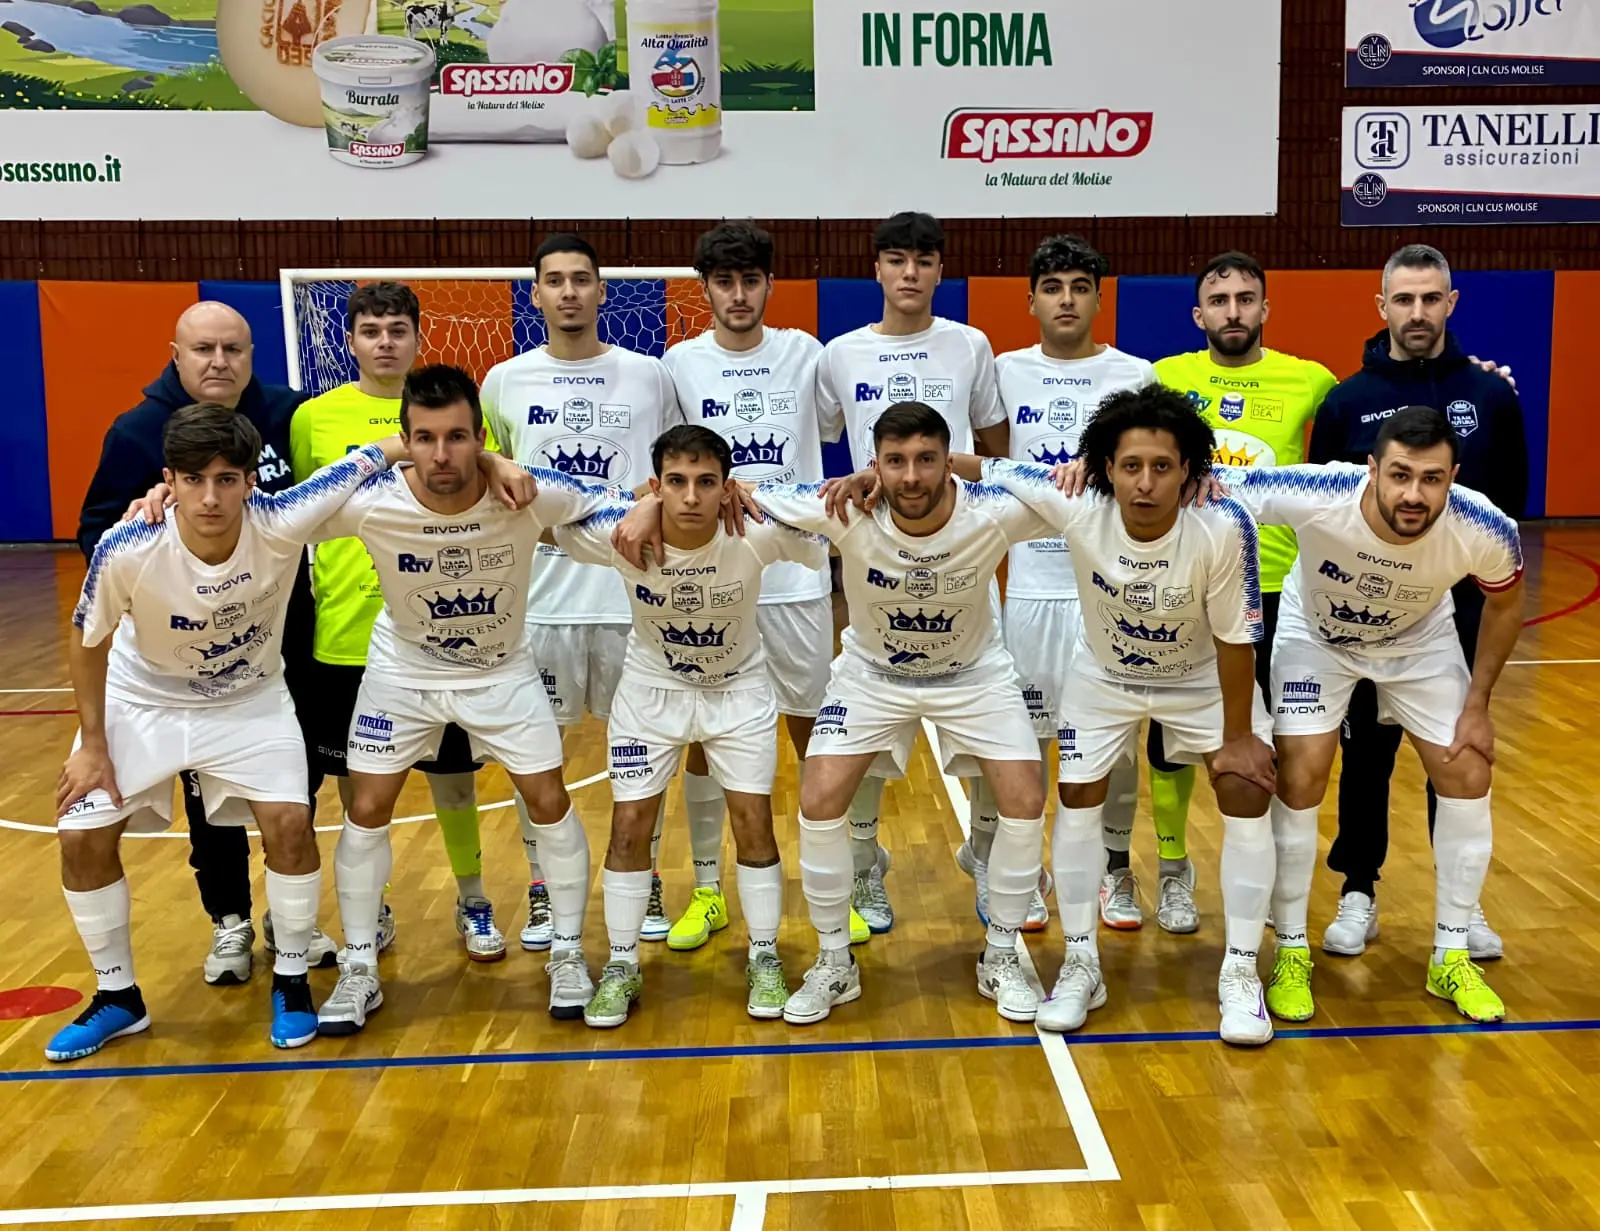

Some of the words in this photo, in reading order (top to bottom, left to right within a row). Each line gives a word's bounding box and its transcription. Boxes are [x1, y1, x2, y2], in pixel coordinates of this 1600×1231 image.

[641, 38, 664, 48] Alta
[667, 36, 709, 50] Qualità
[862, 13, 900, 66] IN
[913, 13, 1053, 66] FORMA
[1360, 44, 1389, 58] CLN
[1422, 66, 1466, 76] SPONSOR
[1471, 65, 1490, 75] CLN
[1491, 65, 1510, 75] CUS
[1511, 64, 1545, 75] MOLISE
[450, 64, 566, 96] SASSANO
[1422, 112, 1600, 146] TANELLI
[960, 111, 1140, 161] SASSANO
[352, 143, 402, 156] SASSANO
[1444, 148, 1580, 166] assicurazioni
[0, 154, 122, 183] sassano.it
[985, 172, 998, 187] la
[1000, 172, 1047, 187] Natura
[1050, 172, 1069, 187] del
[1072, 171, 1113, 187] Molise
[1355, 182, 1384, 196] CLN
[1417, 203, 1460, 213] SPONSOR
[1466, 203, 1484, 213] CLN
[1485, 203, 1504, 213] CUS
[1505, 202, 1538, 212] MOLISE
[878, 352, 929, 362] GIVOVA
[722, 368, 771, 377] GIVOVA
[553, 377, 605, 385] GIVOVA
[1042, 377, 1092, 386] GIVOVA
[1209, 376, 1260, 388] GIVOVA
[924, 390, 944, 398] DEA
[771, 403, 790, 412] DEA
[1252, 409, 1273, 418] DEA
[601, 416, 621, 424] DEA
[731, 448, 779, 464] CADI
[1212, 455, 1252, 467] ADI
[554, 460, 605, 475] CADI
[423, 523, 481, 534] GIVOVA
[481, 558, 504, 567] DEA
[898, 550, 951, 562] GIVOVA
[1118, 555, 1169, 570] GIVOVA
[1357, 551, 1413, 571] GIVOVA
[661, 566, 717, 576] GIVOVA
[196, 572, 252, 594] GIVOVA
[946, 581, 967, 591] DEA
[712, 598, 734, 606] DEA
[1164, 599, 1185, 609] DEA
[434, 601, 490, 617] CADI
[1334, 609, 1390, 626] CADI
[417, 612, 513, 637] ANTINCENDI
[893, 618, 948, 631] CADI
[665, 632, 720, 645] CADI
[1118, 623, 1171, 641] CADI
[1103, 628, 1193, 658] ANTINCENDI
[1029, 711, 1049, 720] OVA
[1277, 705, 1326, 714] GIVOVA
[357, 714, 393, 731] main
[318, 745, 348, 758] GIVOV
[348, 740, 396, 753] GIVOVA
[611, 745, 648, 757] main
[609, 767, 654, 779] GIVOVA
[346, 942, 372, 951] OVA
